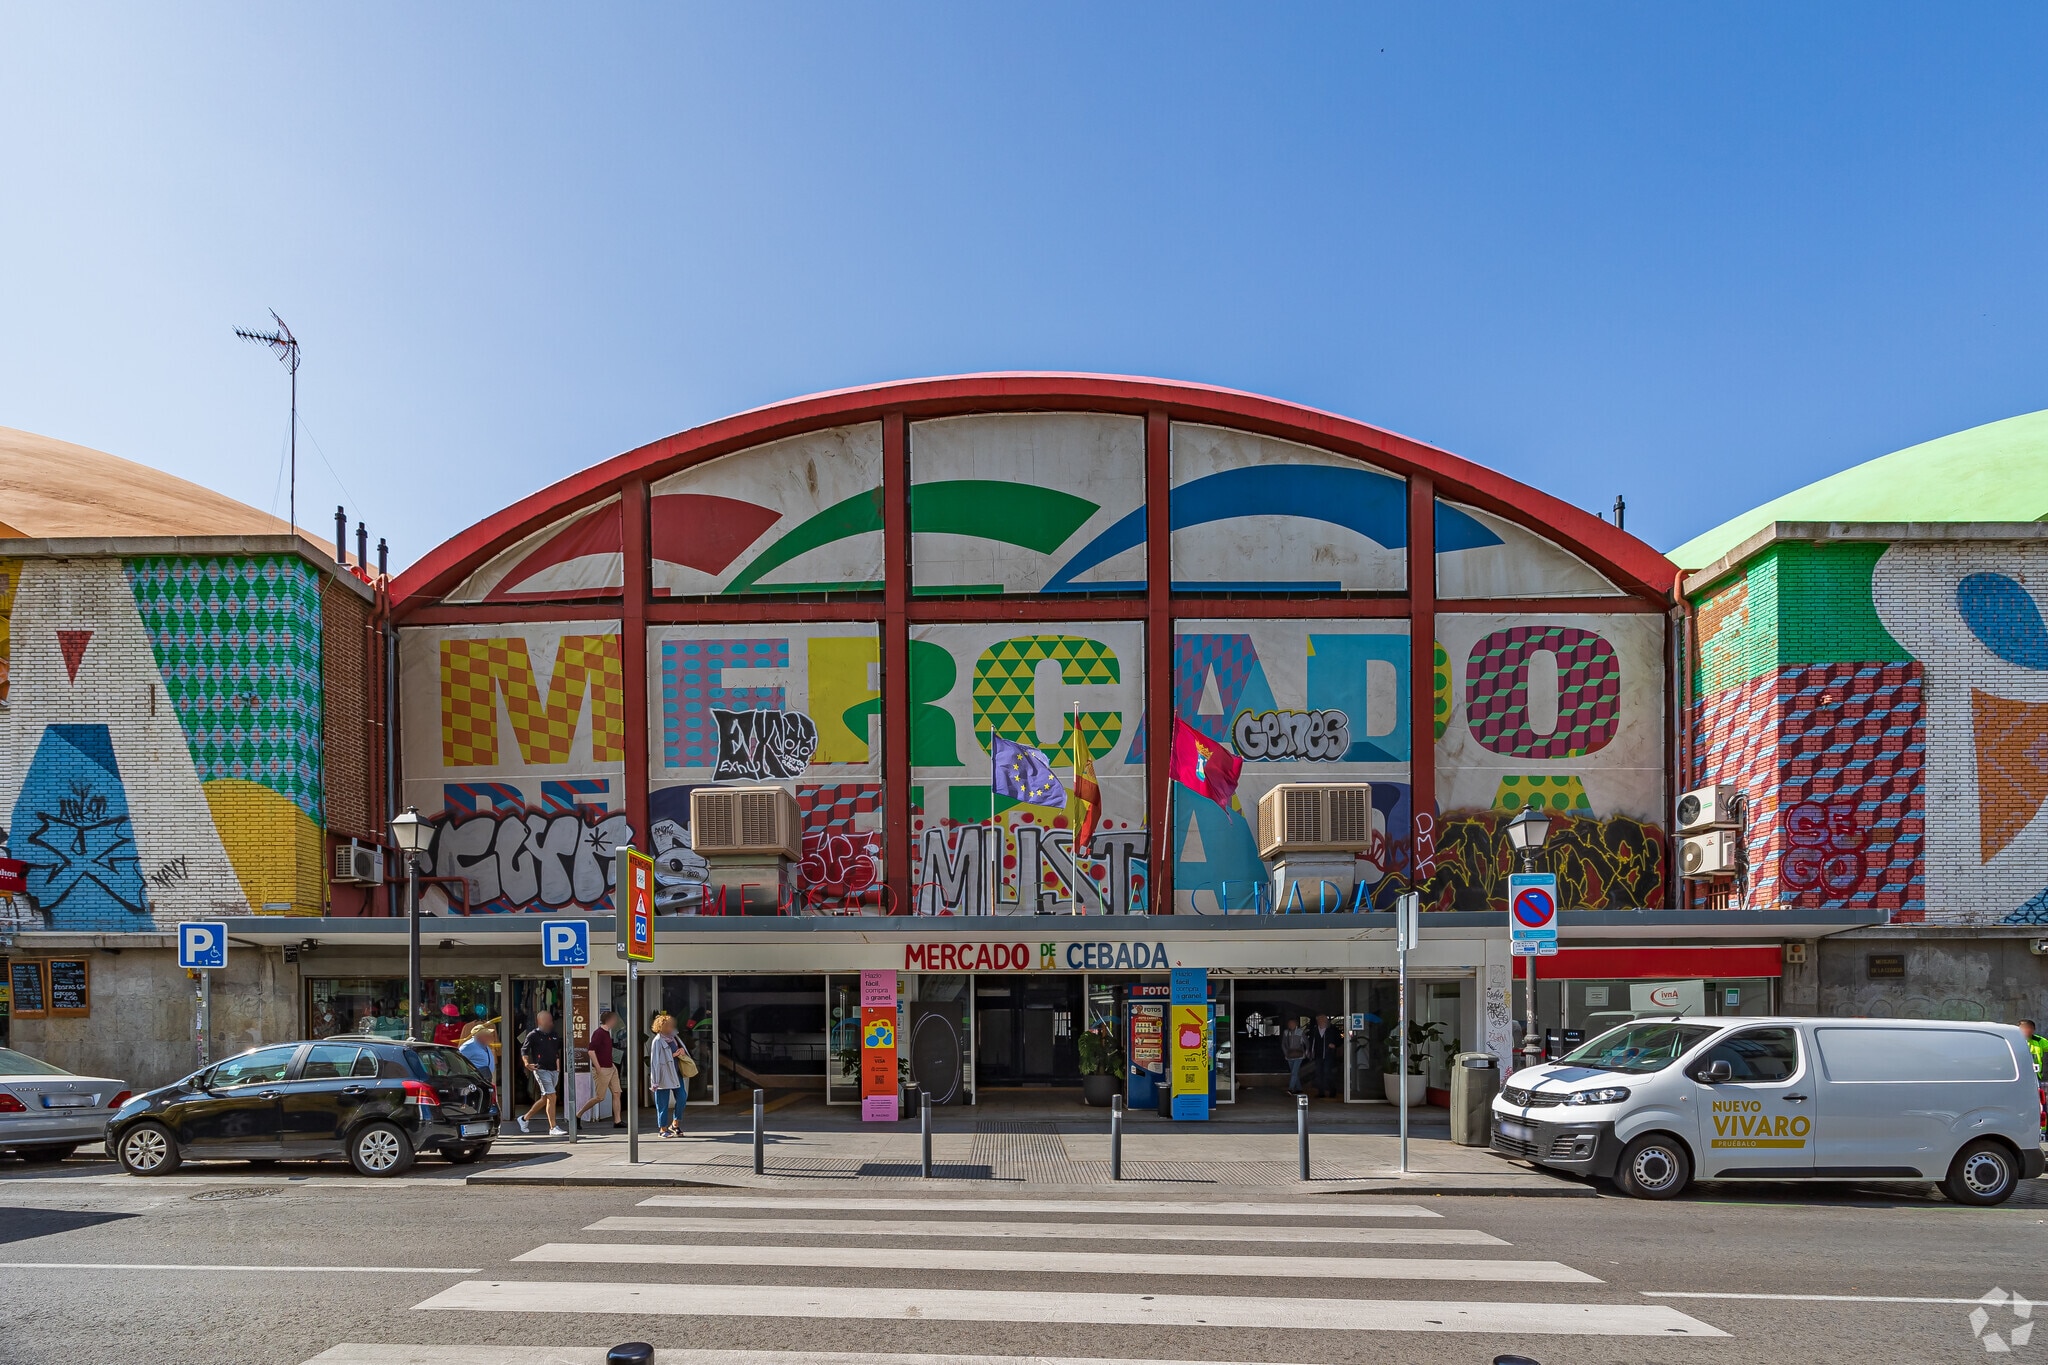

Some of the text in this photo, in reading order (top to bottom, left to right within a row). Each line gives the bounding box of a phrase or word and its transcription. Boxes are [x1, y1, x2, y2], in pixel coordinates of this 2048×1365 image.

[151, 854, 189, 888] NAVY
[636, 922, 646, 936] 20
[186, 928, 214, 963] P
[550, 926, 577, 961] P
[905, 943, 1170, 970] MERCADO DE LA CEBADA
[1712, 1101, 1762, 1113] NUEVO
[1712, 1115, 1811, 1137] VIVARO
